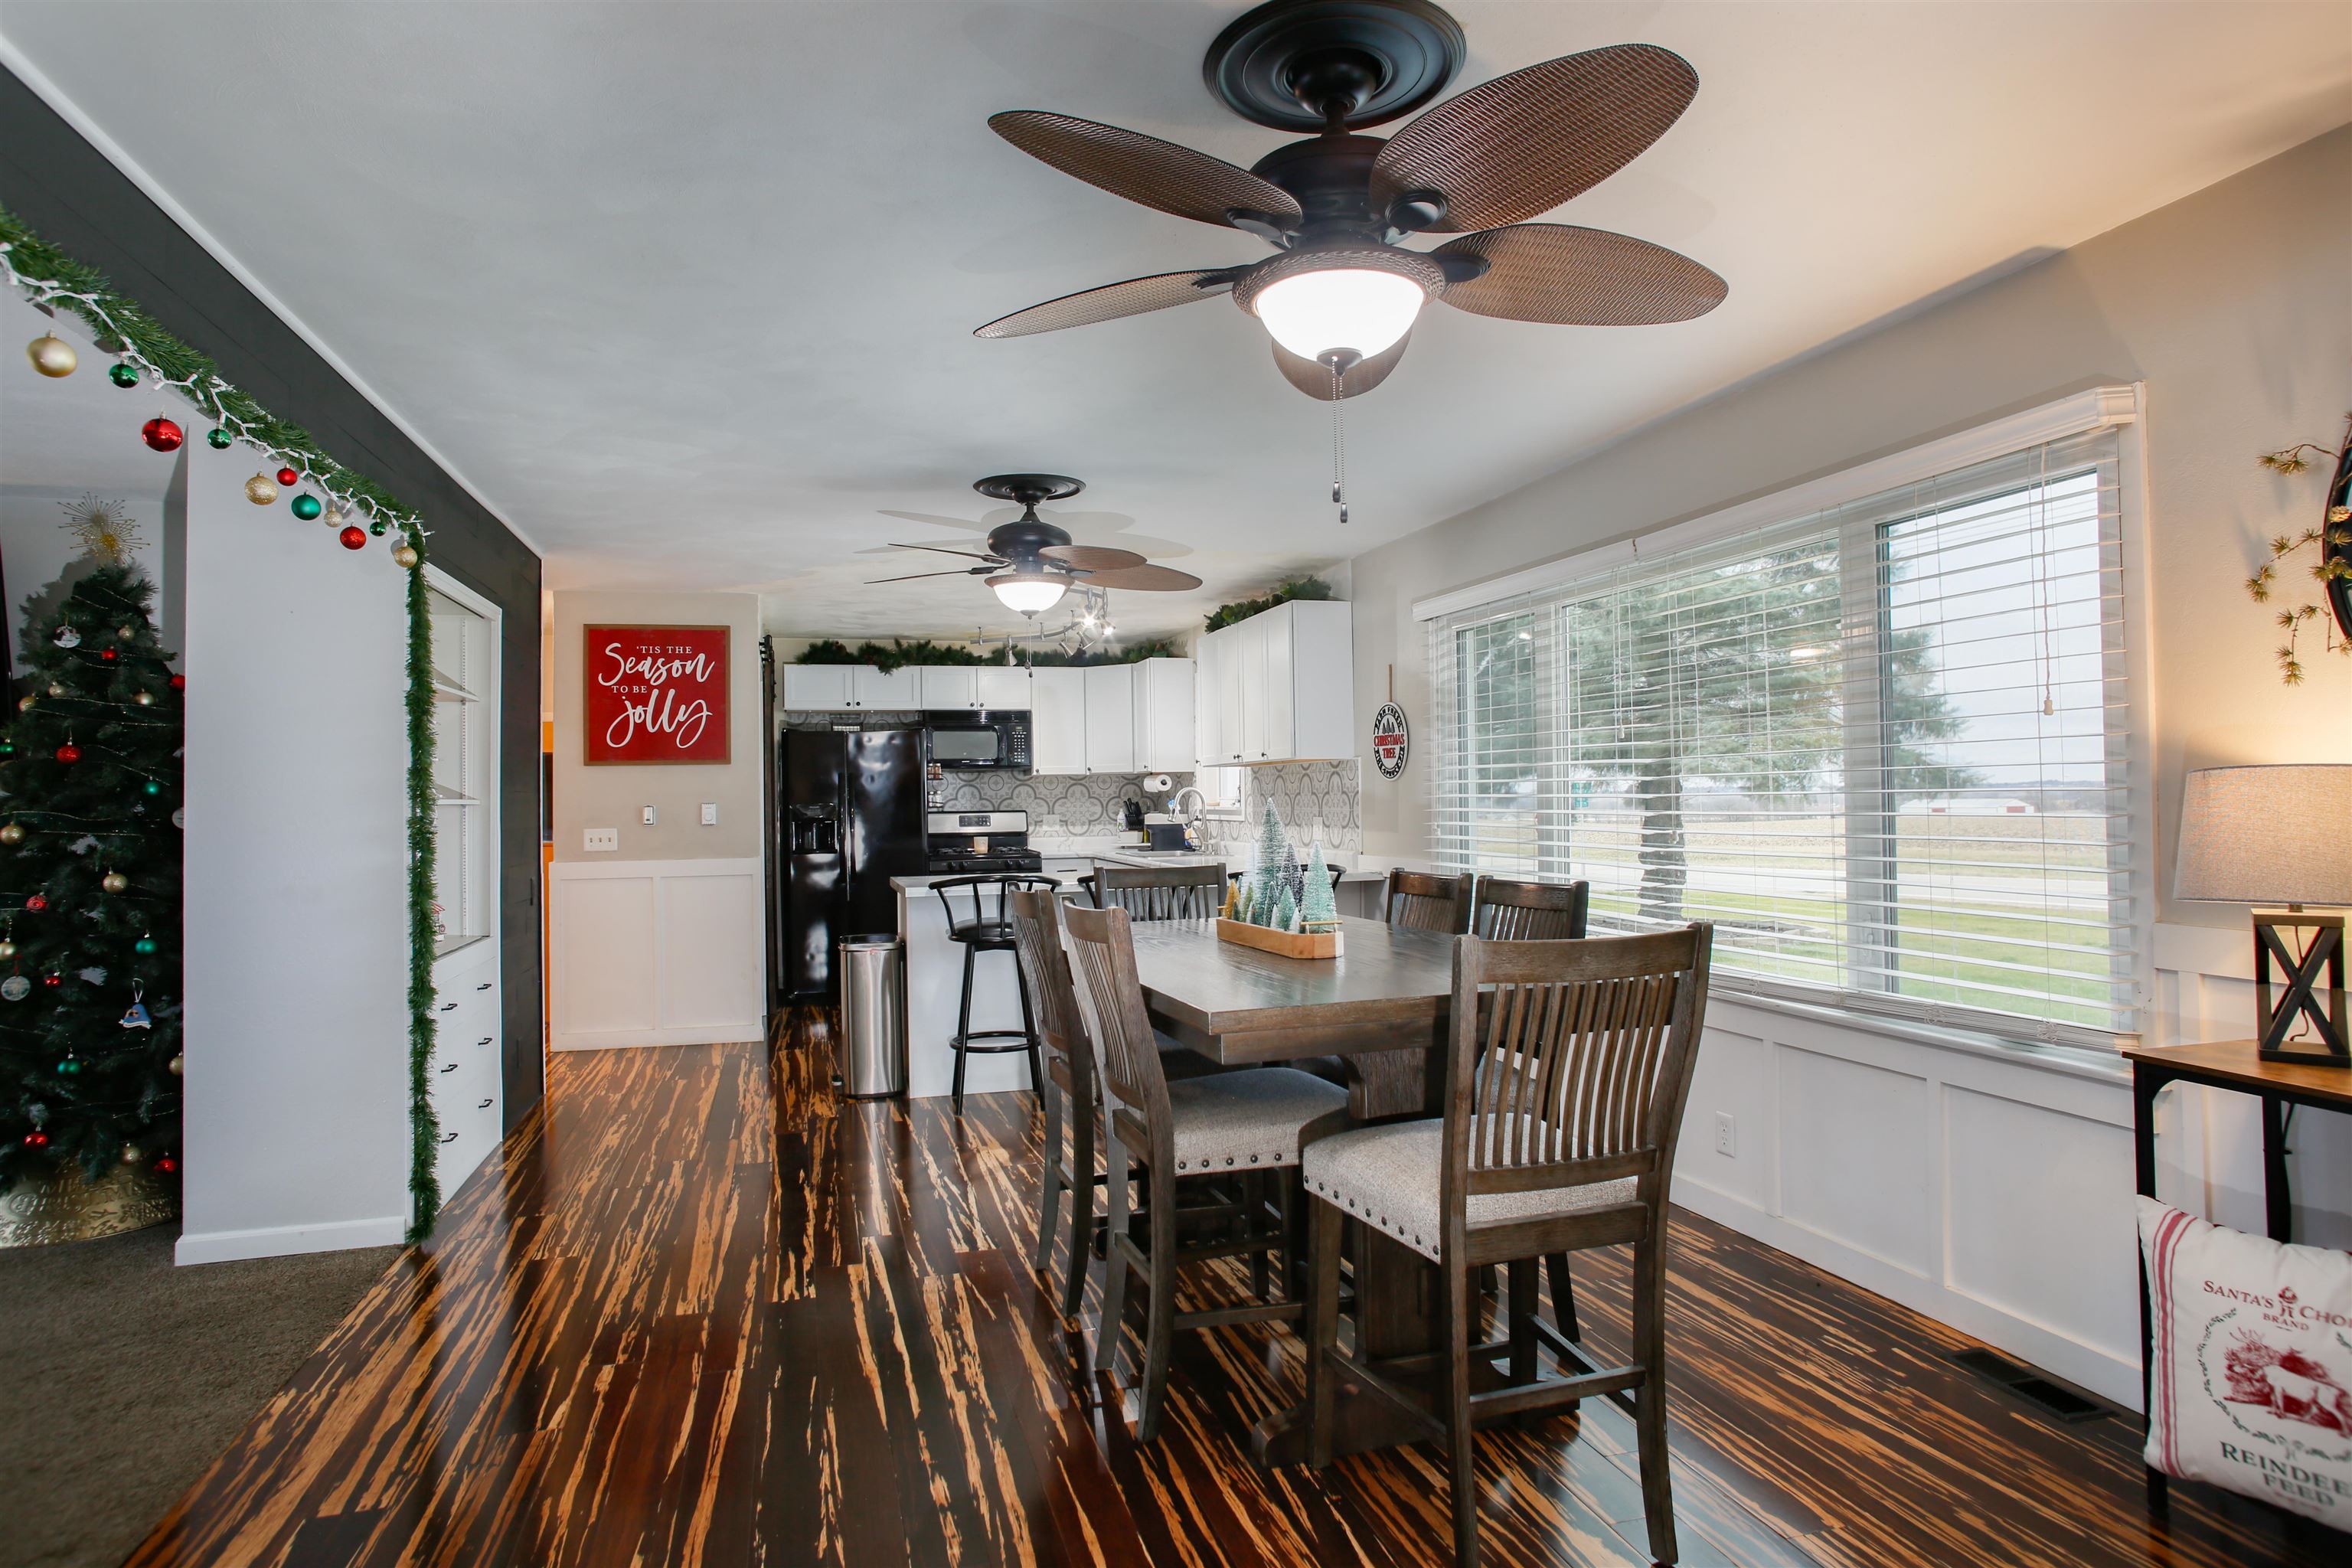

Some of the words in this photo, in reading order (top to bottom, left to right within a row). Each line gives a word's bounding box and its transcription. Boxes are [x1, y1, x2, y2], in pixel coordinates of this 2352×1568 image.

[666, 645, 693, 654] THE
[598, 642, 715, 686] Season
[606, 688, 713, 748] jolly
[1387, 707, 1403, 727] FRESH
[1374, 733, 1405, 746] CHRISTMAS
[1383, 747, 1396, 758] TREE
[2203, 1280, 2274, 1309] SANTA'S
[2262, 1313, 2309, 1331] BRAND
[2262, 1472, 2336, 1508] FEED
